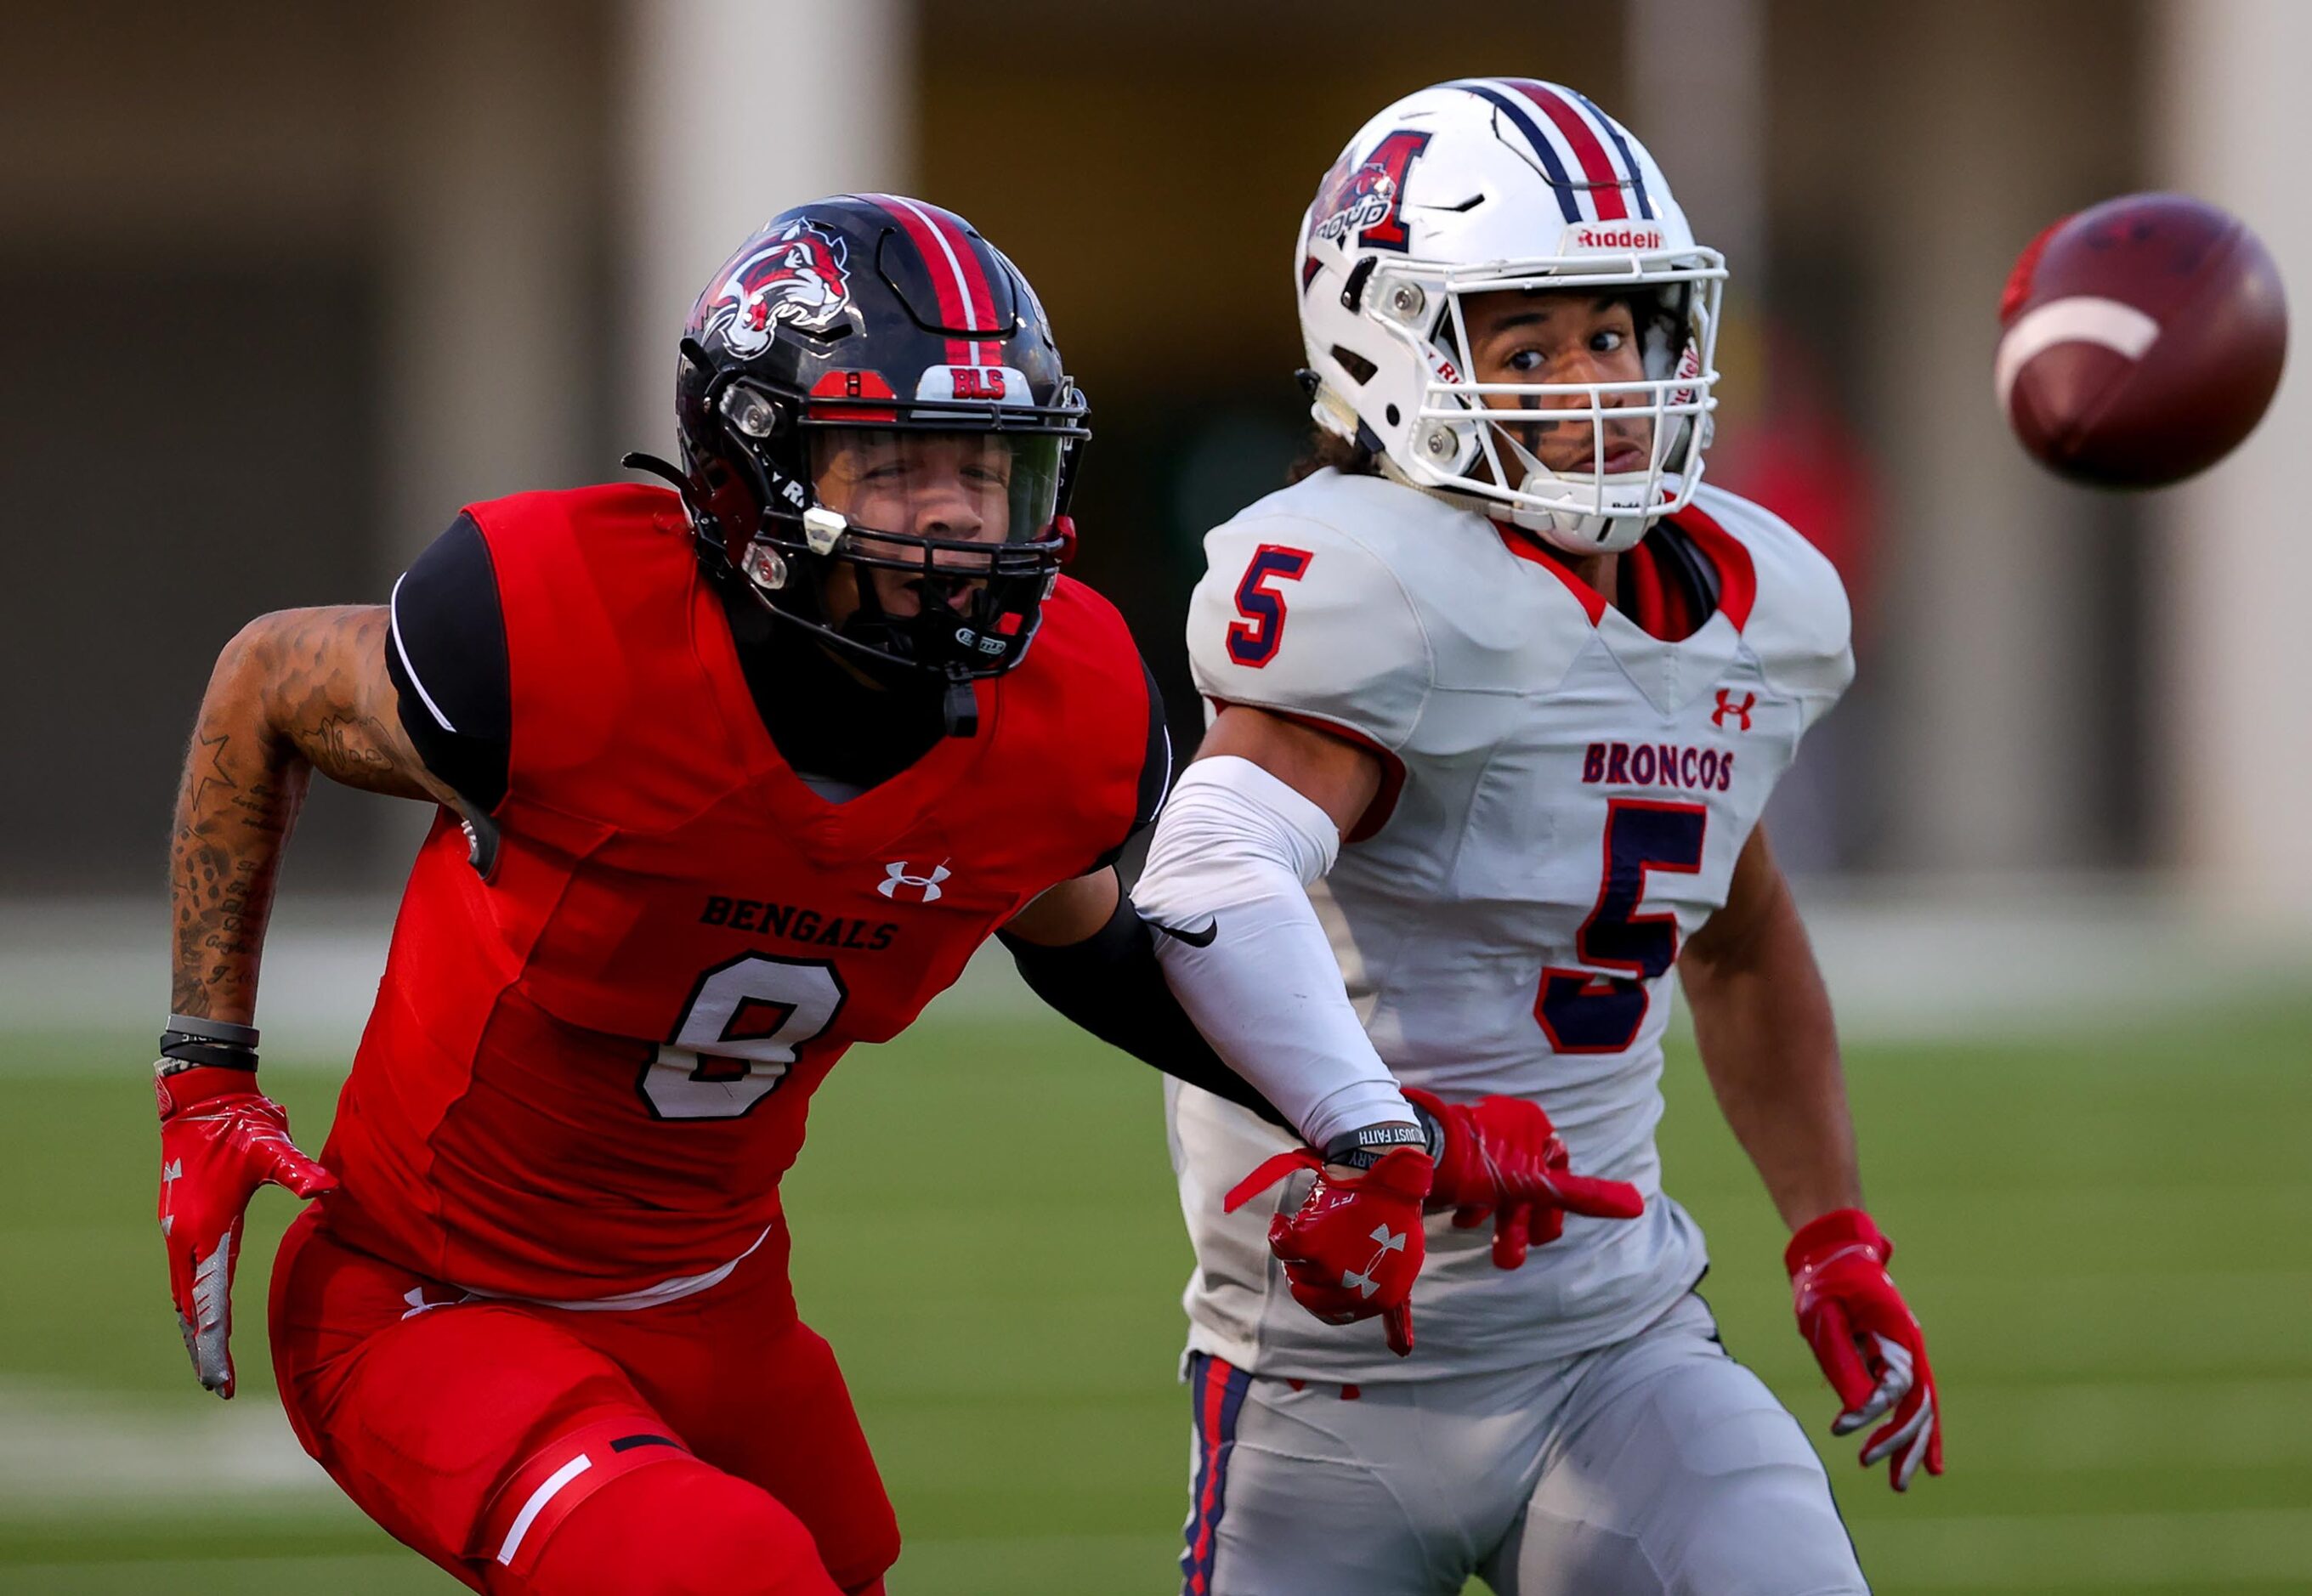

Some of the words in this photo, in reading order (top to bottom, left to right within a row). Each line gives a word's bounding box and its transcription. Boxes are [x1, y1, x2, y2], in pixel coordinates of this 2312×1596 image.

[1578, 229, 1659, 249] Riddell
[847, 371, 861, 398] 8
[950, 369, 1006, 400] BLS
[1227, 544, 1314, 669] 5
[961, 631, 1004, 653] BTLE
[1582, 742, 1735, 792] BRONCOS
[699, 895, 899, 951] BENGALS
[1534, 798, 1707, 1054] 5
[635, 948, 849, 1122] 8
[1359, 1129, 1392, 1145] FAITH
[1392, 1128, 1415, 1144] JUST
